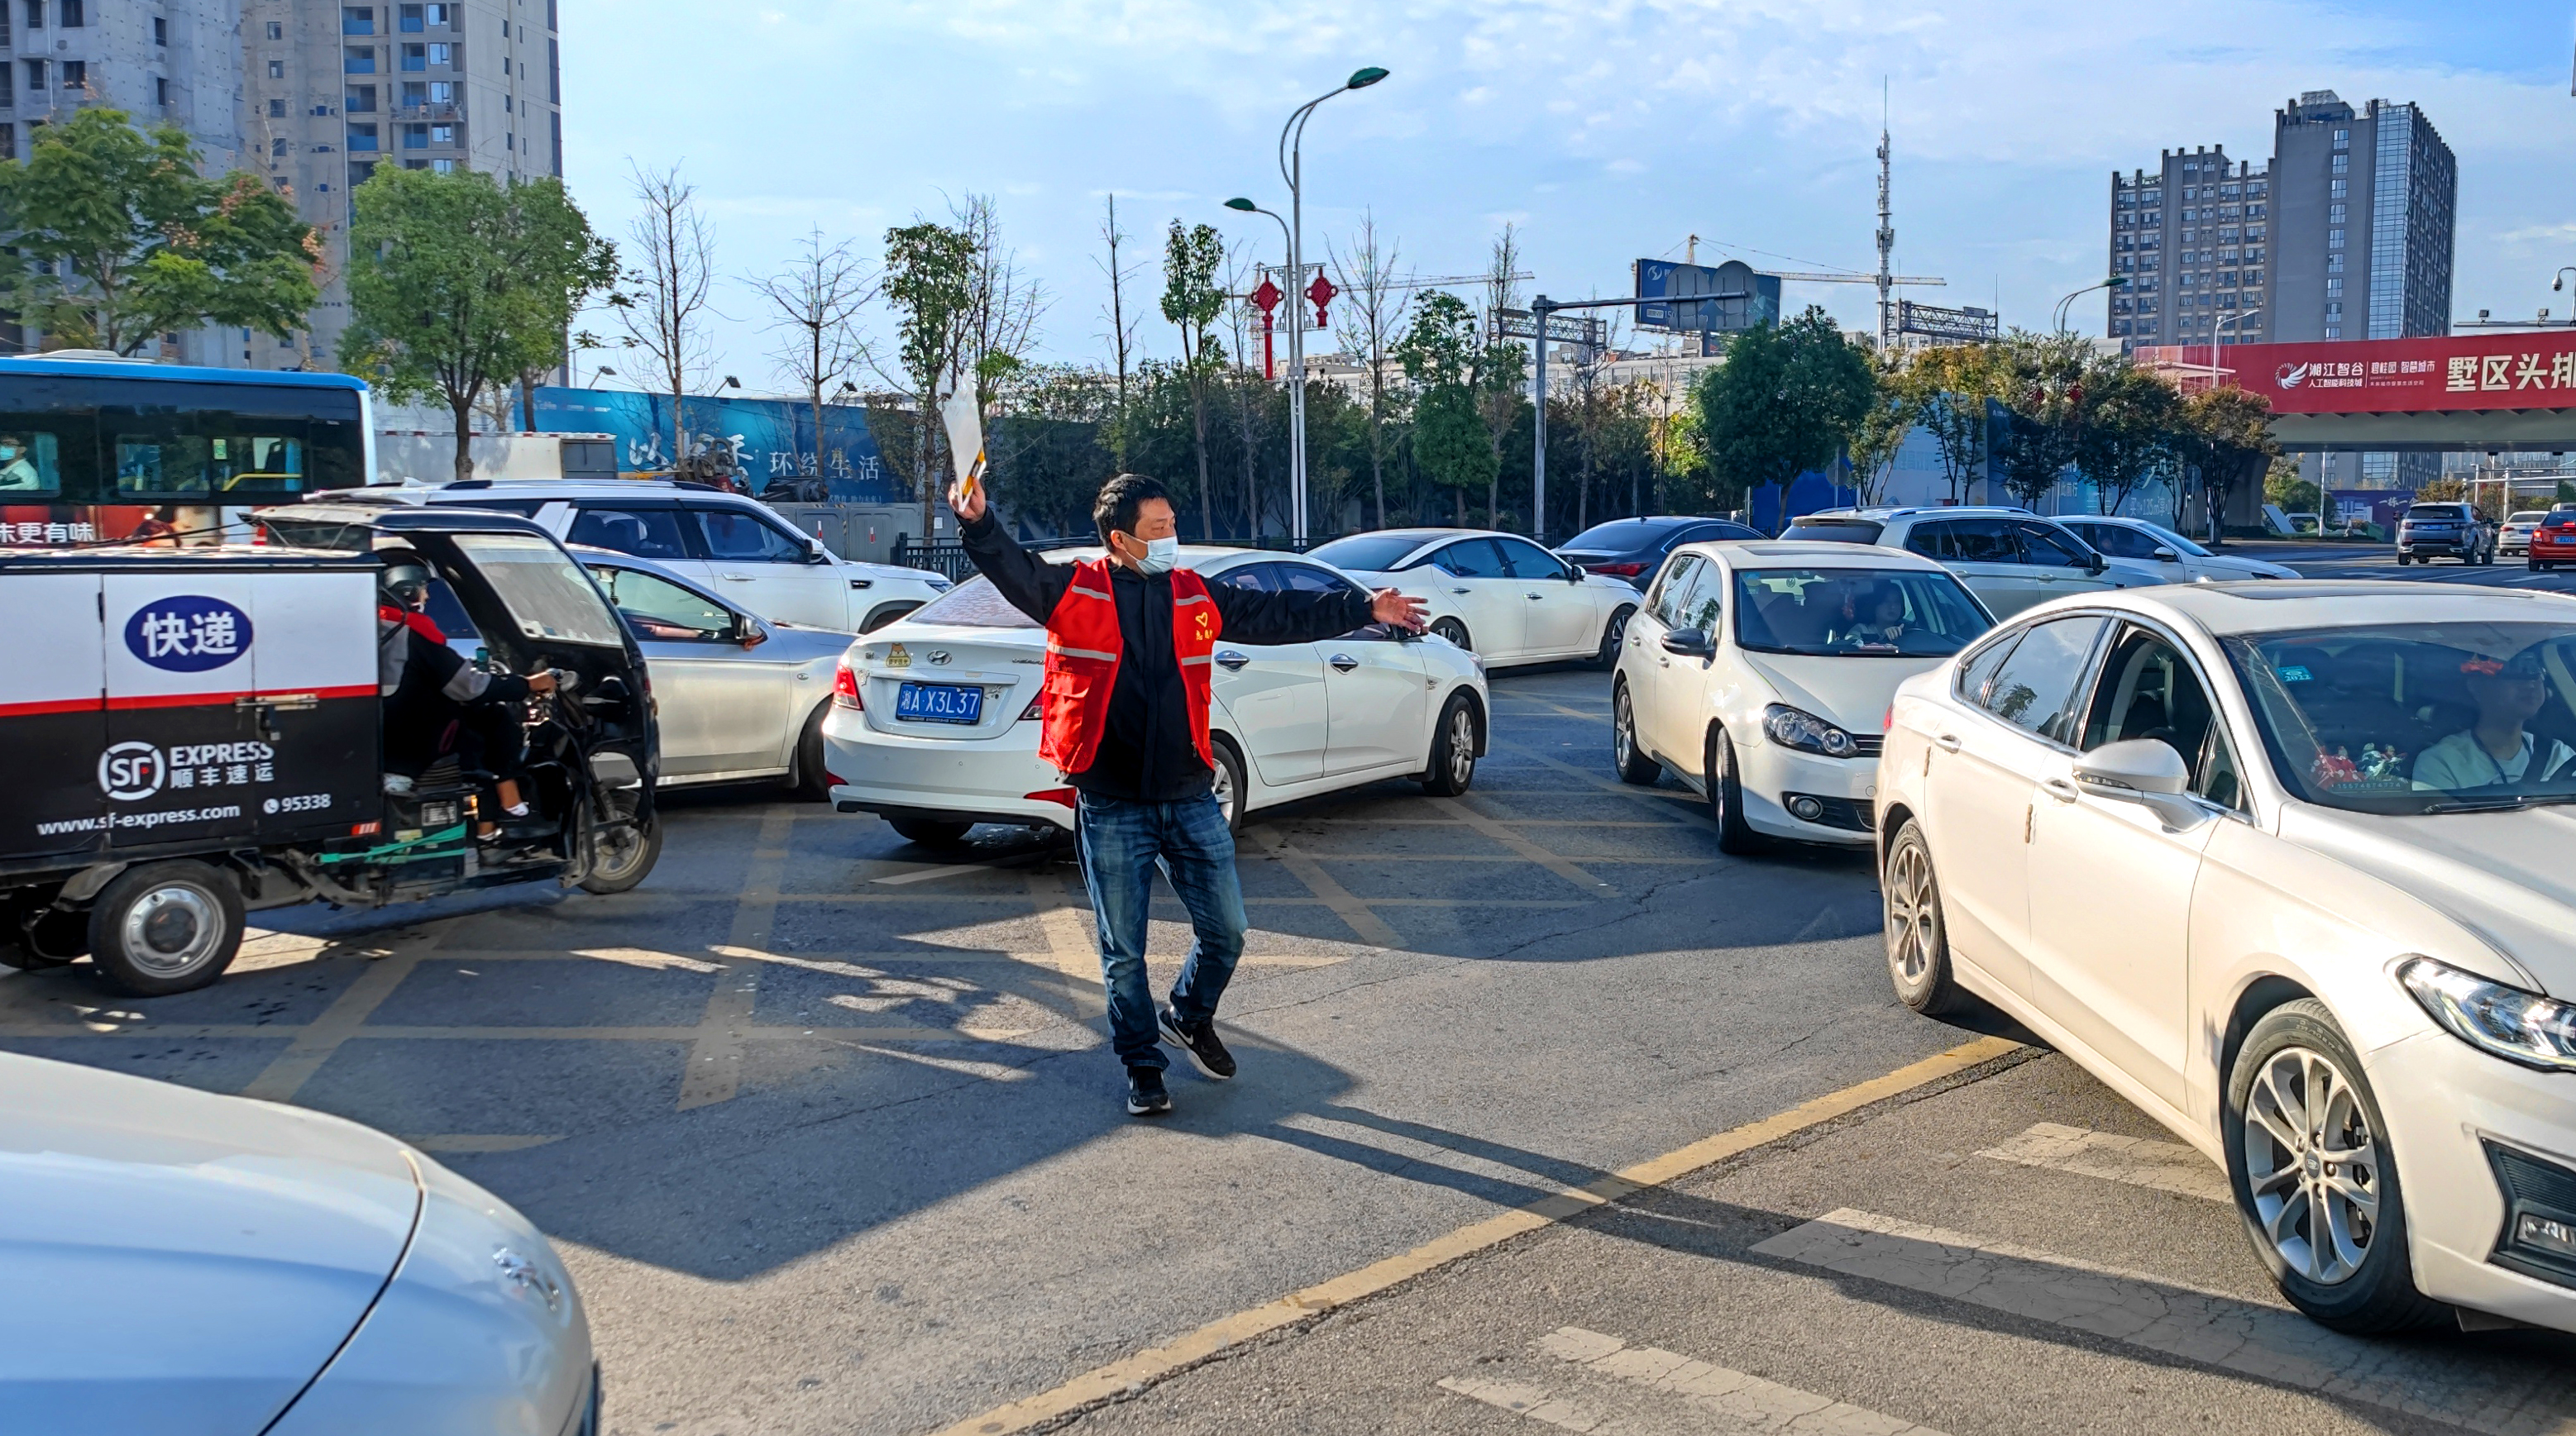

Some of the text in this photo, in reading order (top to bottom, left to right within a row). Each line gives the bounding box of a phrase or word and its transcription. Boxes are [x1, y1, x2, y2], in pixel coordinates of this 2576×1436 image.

[2308, 361, 2364, 377] 湘江智谷
[2445, 351, 2576, 392] 墅区头排
[2307, 378, 2363, 389] 人工智能科技城
[769, 450, 880, 481] 环绕生活
[141, 611, 239, 658] 快递
[2284, 674, 2311, 682] 2022
[169, 742, 275, 767] EXPRESS
[170, 763, 275, 790] 顺丰速运
[36, 794, 332, 836] www.sf-express.com 95338
